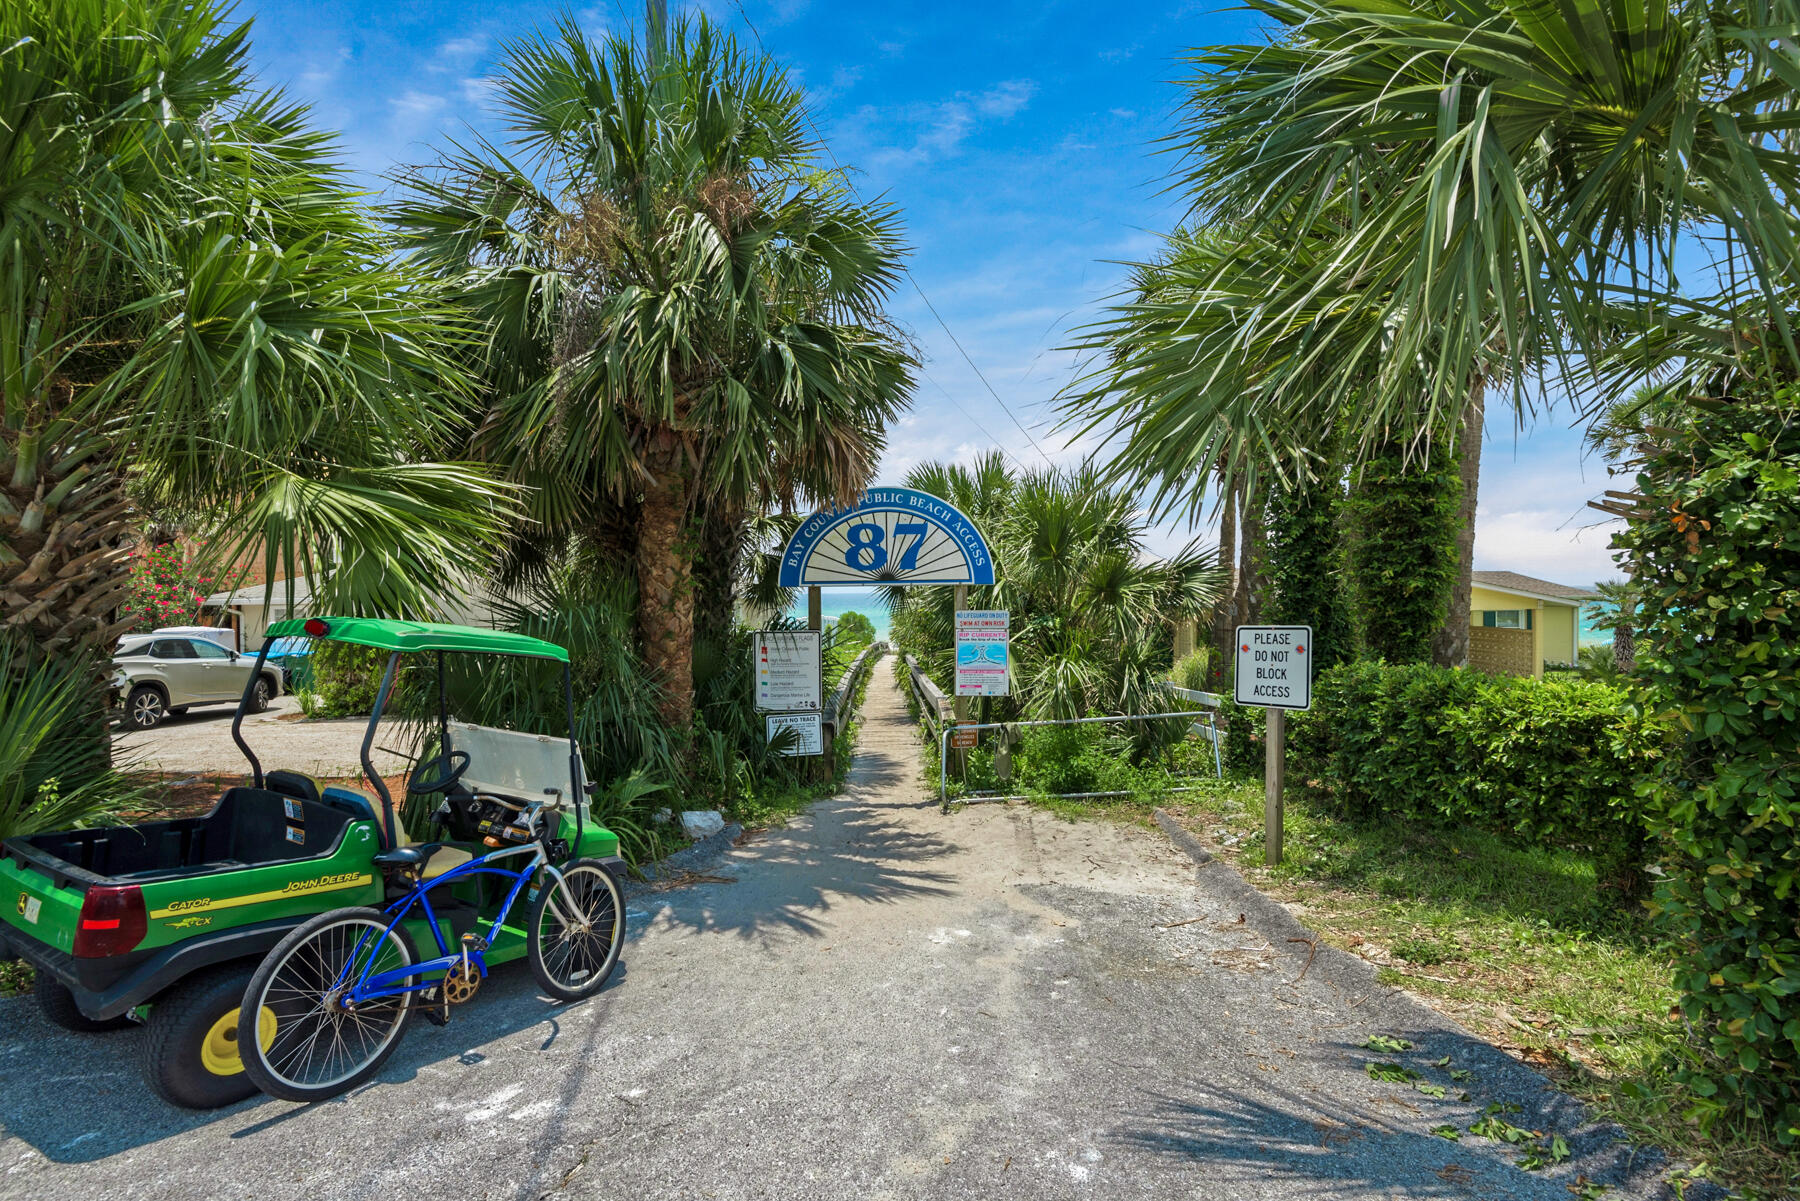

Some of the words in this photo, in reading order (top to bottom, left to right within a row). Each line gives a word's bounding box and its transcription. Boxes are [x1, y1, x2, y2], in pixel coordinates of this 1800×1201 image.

[788, 540, 805, 567] BAY
[909, 495, 952, 522] BEACH
[952, 521, 985, 567] ACCESS
[845, 522, 928, 571] 87
[1254, 633, 1291, 645] PLEASE
[1255, 650, 1268, 662] DO
[1271, 650, 1290, 662] NOT
[1256, 667, 1287, 680] BLOCK
[1253, 684, 1290, 698] ACCESS
[282, 878, 319, 893] JOHN
[319, 872, 360, 887] DEERE
[167, 897, 211, 912] GATOR
[195, 917, 212, 927] CX
